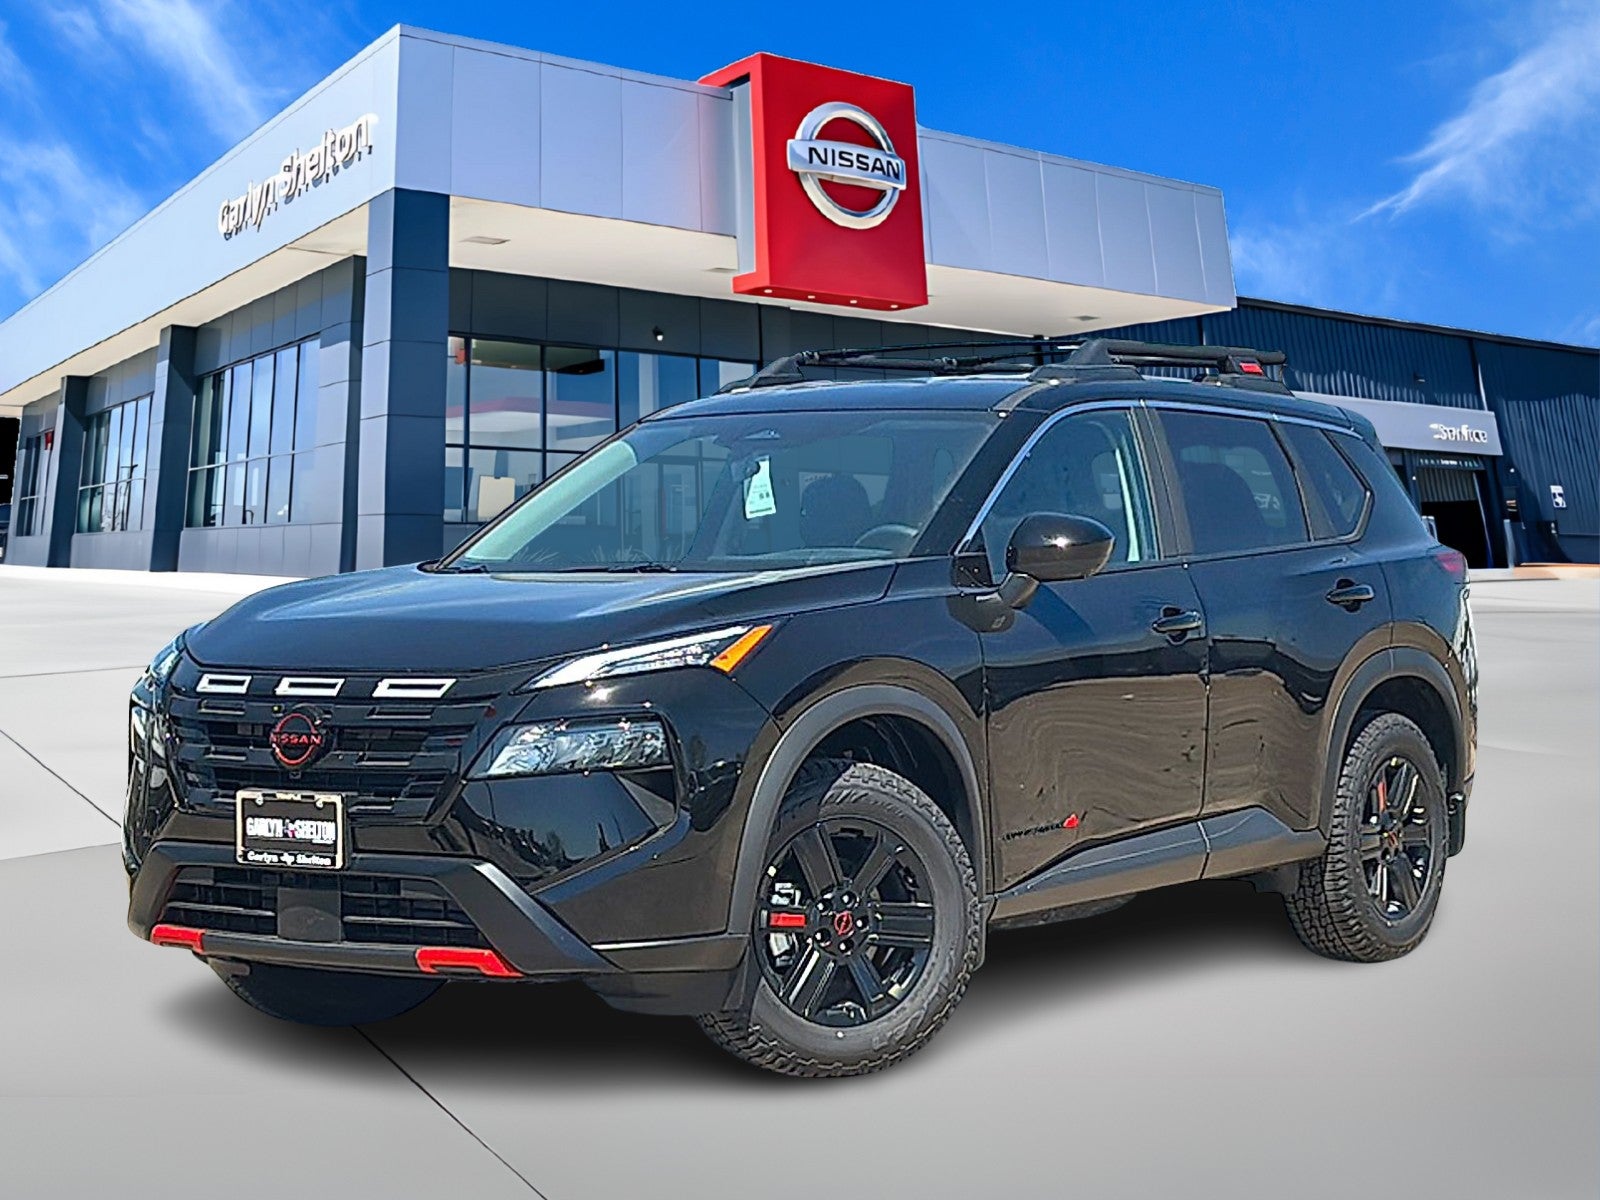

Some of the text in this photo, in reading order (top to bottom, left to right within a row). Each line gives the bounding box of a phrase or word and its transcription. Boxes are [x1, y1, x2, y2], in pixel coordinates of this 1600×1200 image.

[808, 146, 900, 181] NISSAN
[218, 113, 374, 236] Garlyn Shelton
[1429, 423, 1488, 443] Service
[270, 732, 321, 745] NISSAN
[294, 819, 336, 840] SHELTON
